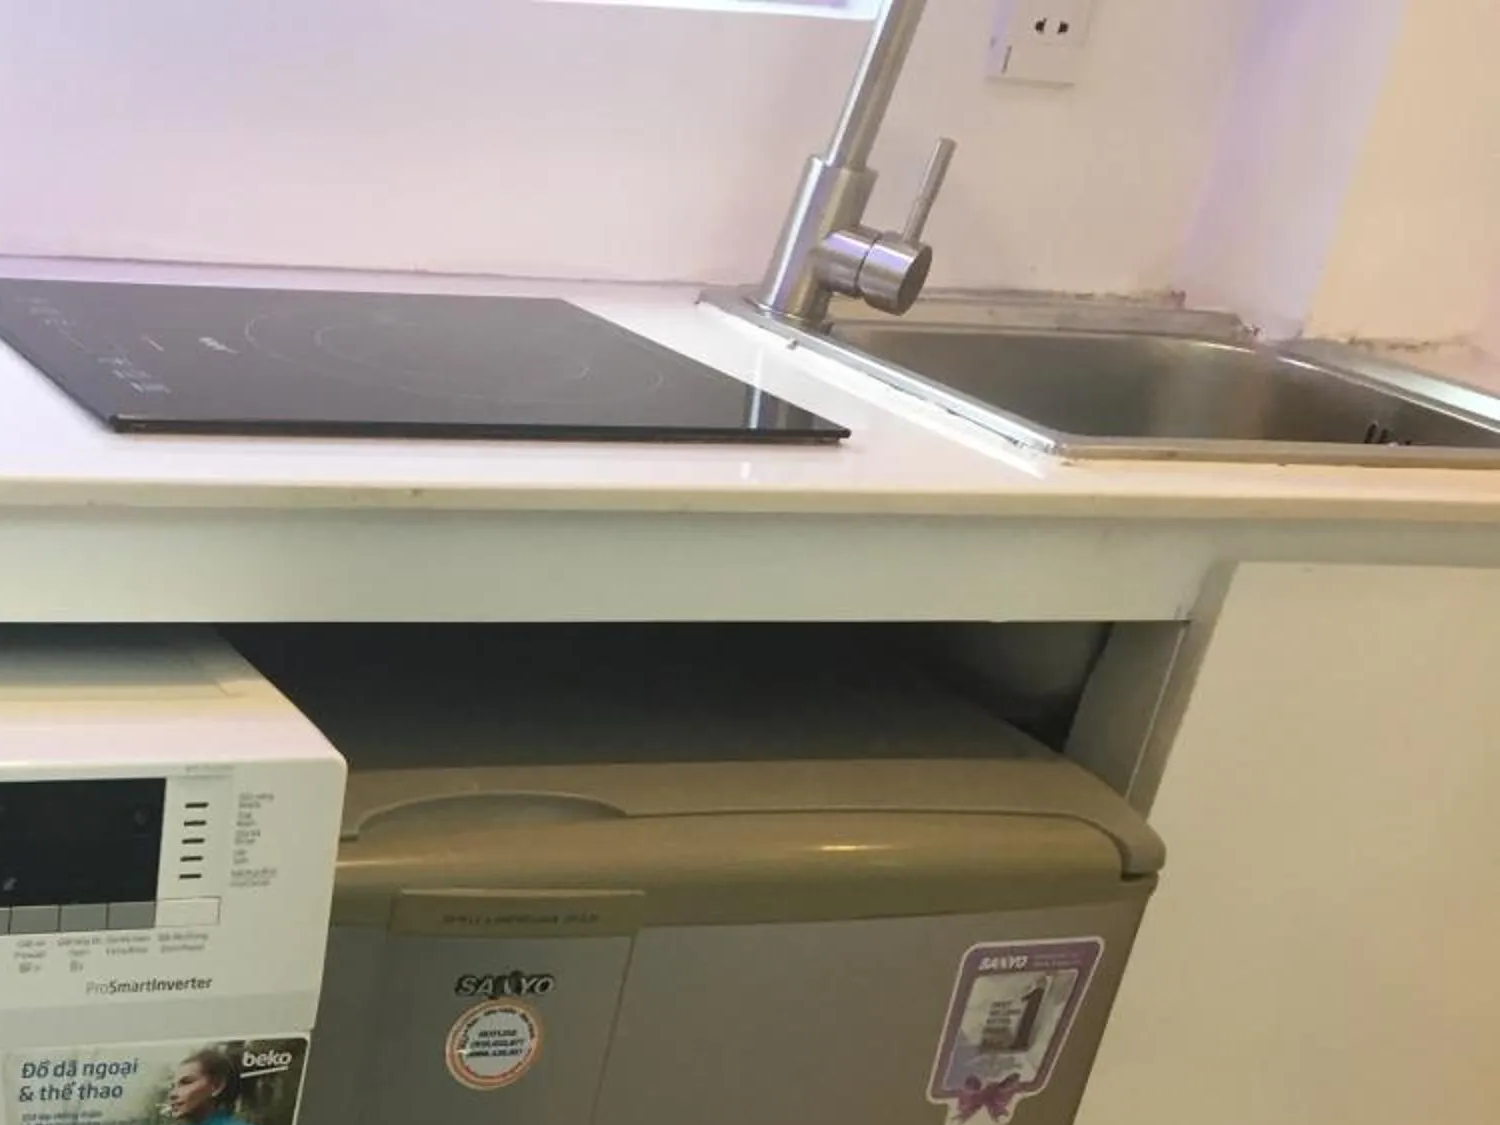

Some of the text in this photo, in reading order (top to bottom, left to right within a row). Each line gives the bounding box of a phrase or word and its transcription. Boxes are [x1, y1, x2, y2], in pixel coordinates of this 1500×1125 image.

[85, 976, 213, 996] ProSmartInverter
[20, 1058, 50, 1079] Đồ
[81, 1058, 140, 1080] ngoại
[242, 1050, 293, 1068] beko
[18, 1080, 124, 1102] & thể thao
